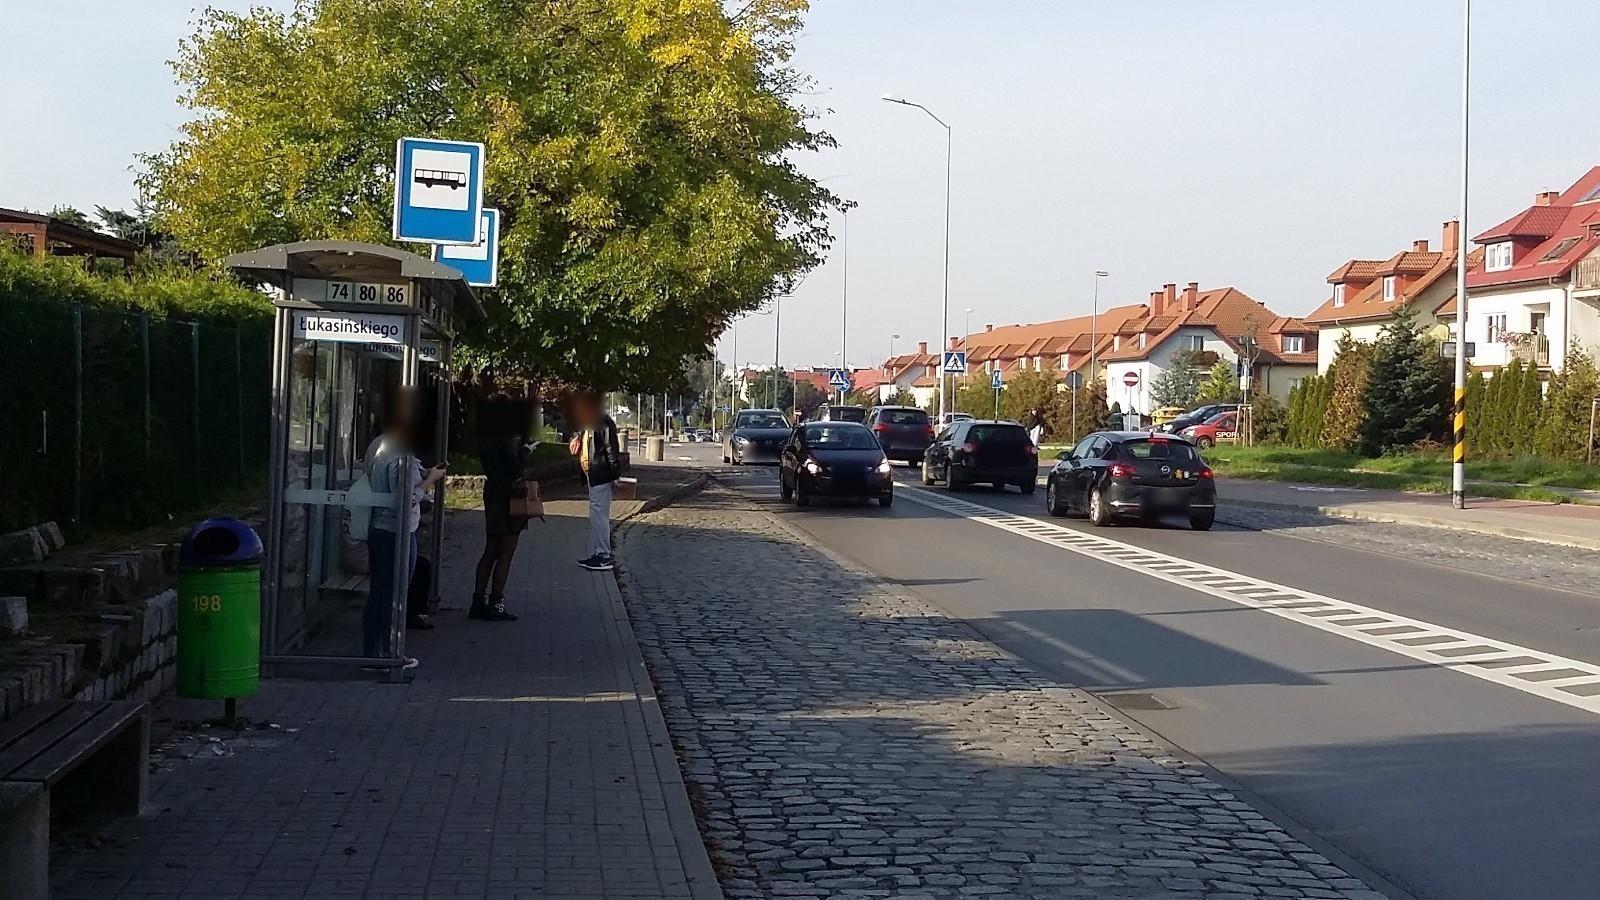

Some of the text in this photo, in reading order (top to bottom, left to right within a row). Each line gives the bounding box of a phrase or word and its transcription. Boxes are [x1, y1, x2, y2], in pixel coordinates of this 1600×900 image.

[332, 283, 404, 302] 74 80 86
[299, 316, 398, 338] Łukasińskiego
[192, 595, 221, 611] 198
